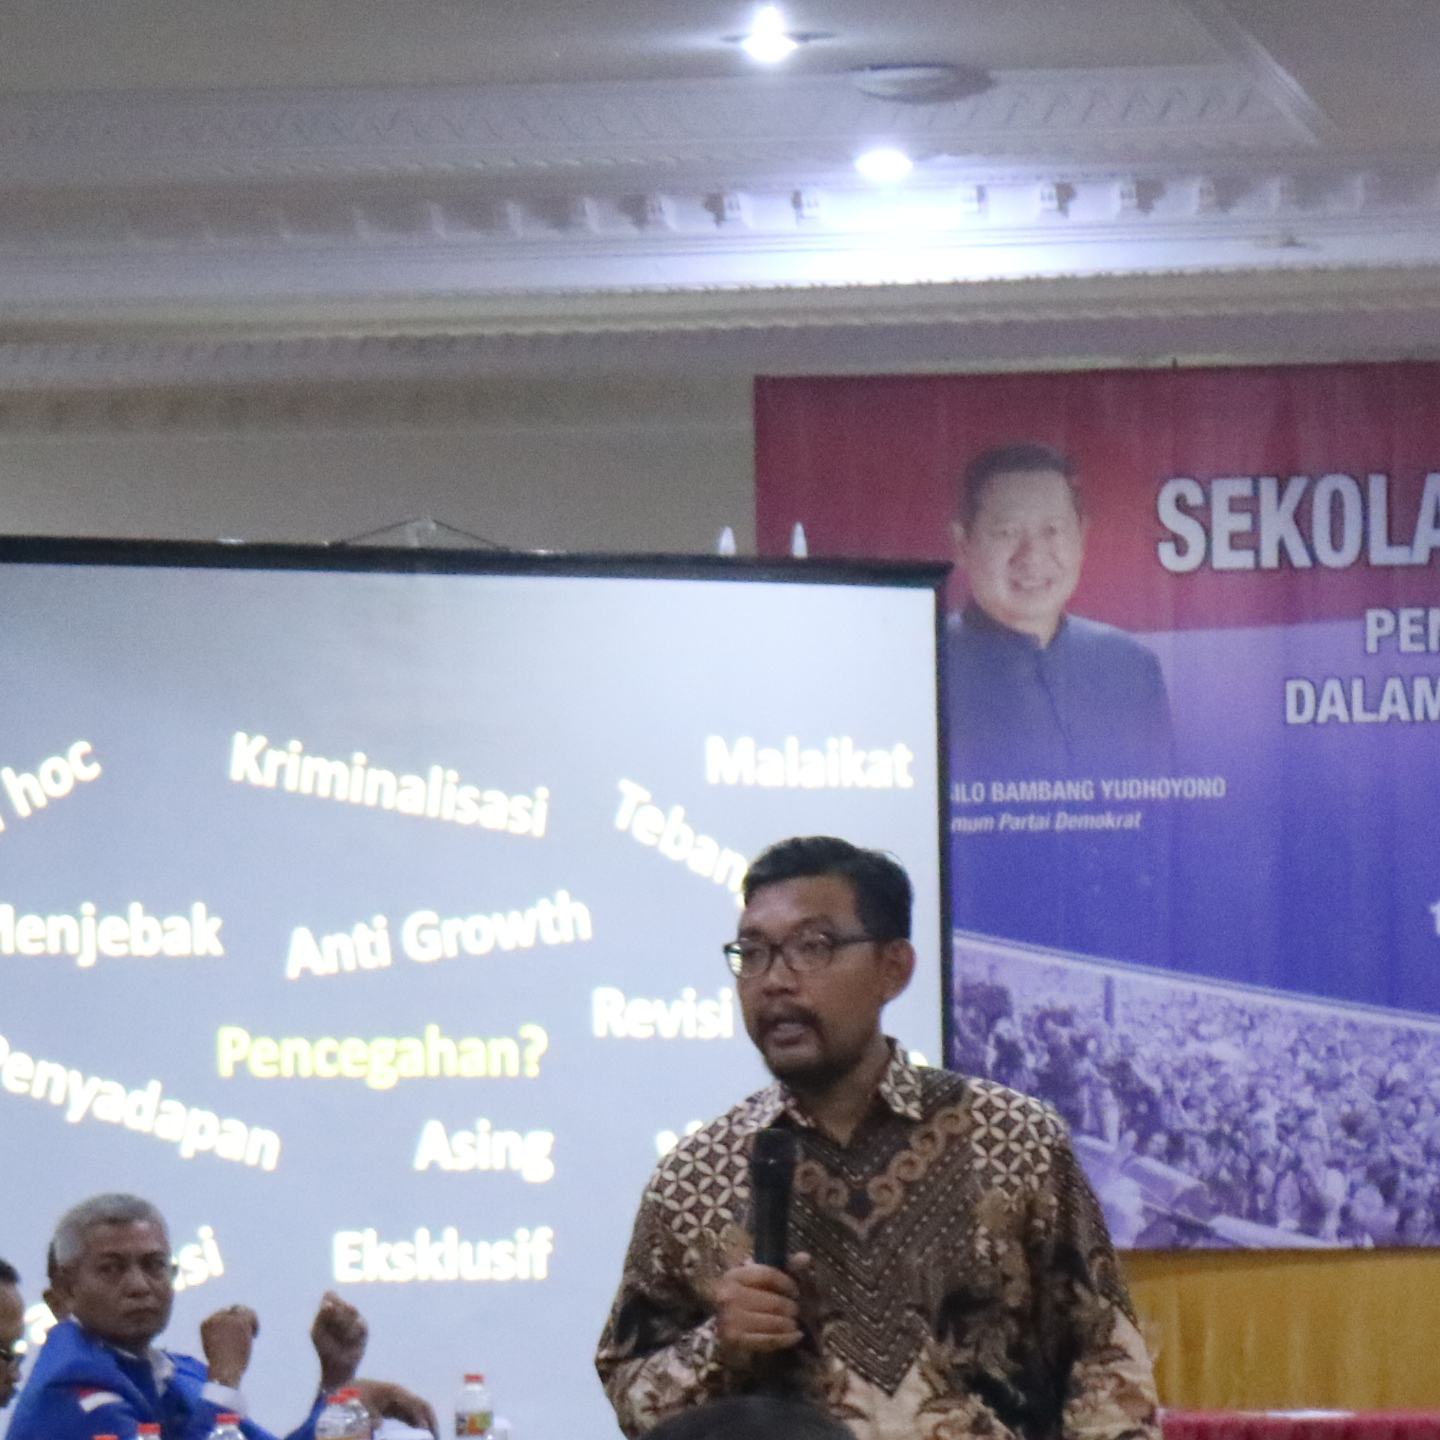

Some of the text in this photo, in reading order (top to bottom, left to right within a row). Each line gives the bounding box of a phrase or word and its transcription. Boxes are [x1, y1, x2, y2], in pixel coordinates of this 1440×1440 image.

[3, 738, 101, 818] hoc
[230, 731, 549, 838] Kriminalisasi
[706, 735, 913, 788] Malaikat
[991, 780, 1094, 802] BAMBANG
[1101, 776, 1227, 799] YUDHOYONO
[615, 777, 750, 909] Teban
[999, 812, 1051, 831] Partai
[1055, 811, 1143, 831] Demokrat
[285, 890, 592, 979] Anti Growth
[593, 987, 733, 1038] Revisi
[217, 1025, 547, 1089] Pencegahan?
[414, 1119, 555, 1183] Asing
[333, 1228, 552, 1283] Eksklusif
